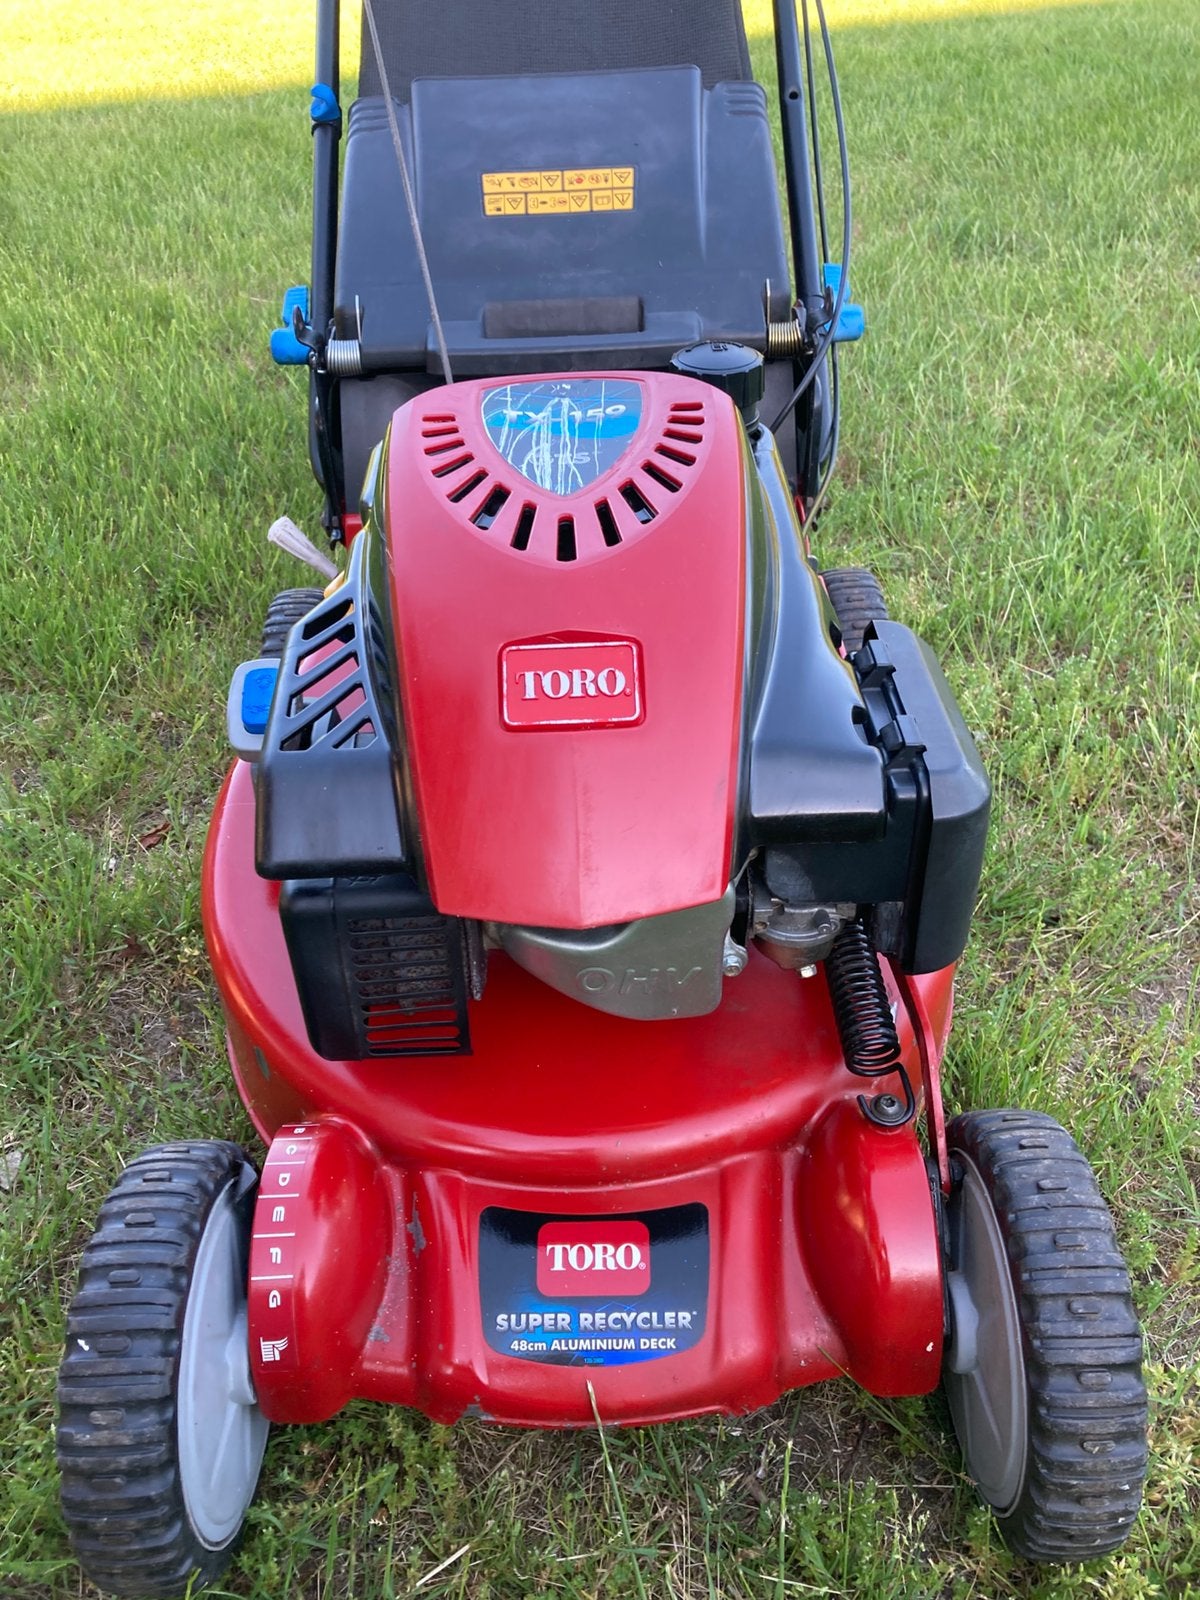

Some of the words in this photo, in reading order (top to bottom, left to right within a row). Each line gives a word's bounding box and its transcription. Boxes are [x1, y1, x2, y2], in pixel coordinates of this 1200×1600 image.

[286, 1144, 297, 1155] C
[278, 1172, 291, 1187] D
[271, 1206, 286, 1223] E
[269, 1247, 283, 1265] F
[268, 1289, 282, 1309] G
[495, 1312, 572, 1333] SUPER
[510, 1339, 547, 1352] 48cm
[550, 1338, 636, 1351] ALUMINIUM
[639, 1337, 677, 1350] DECK
